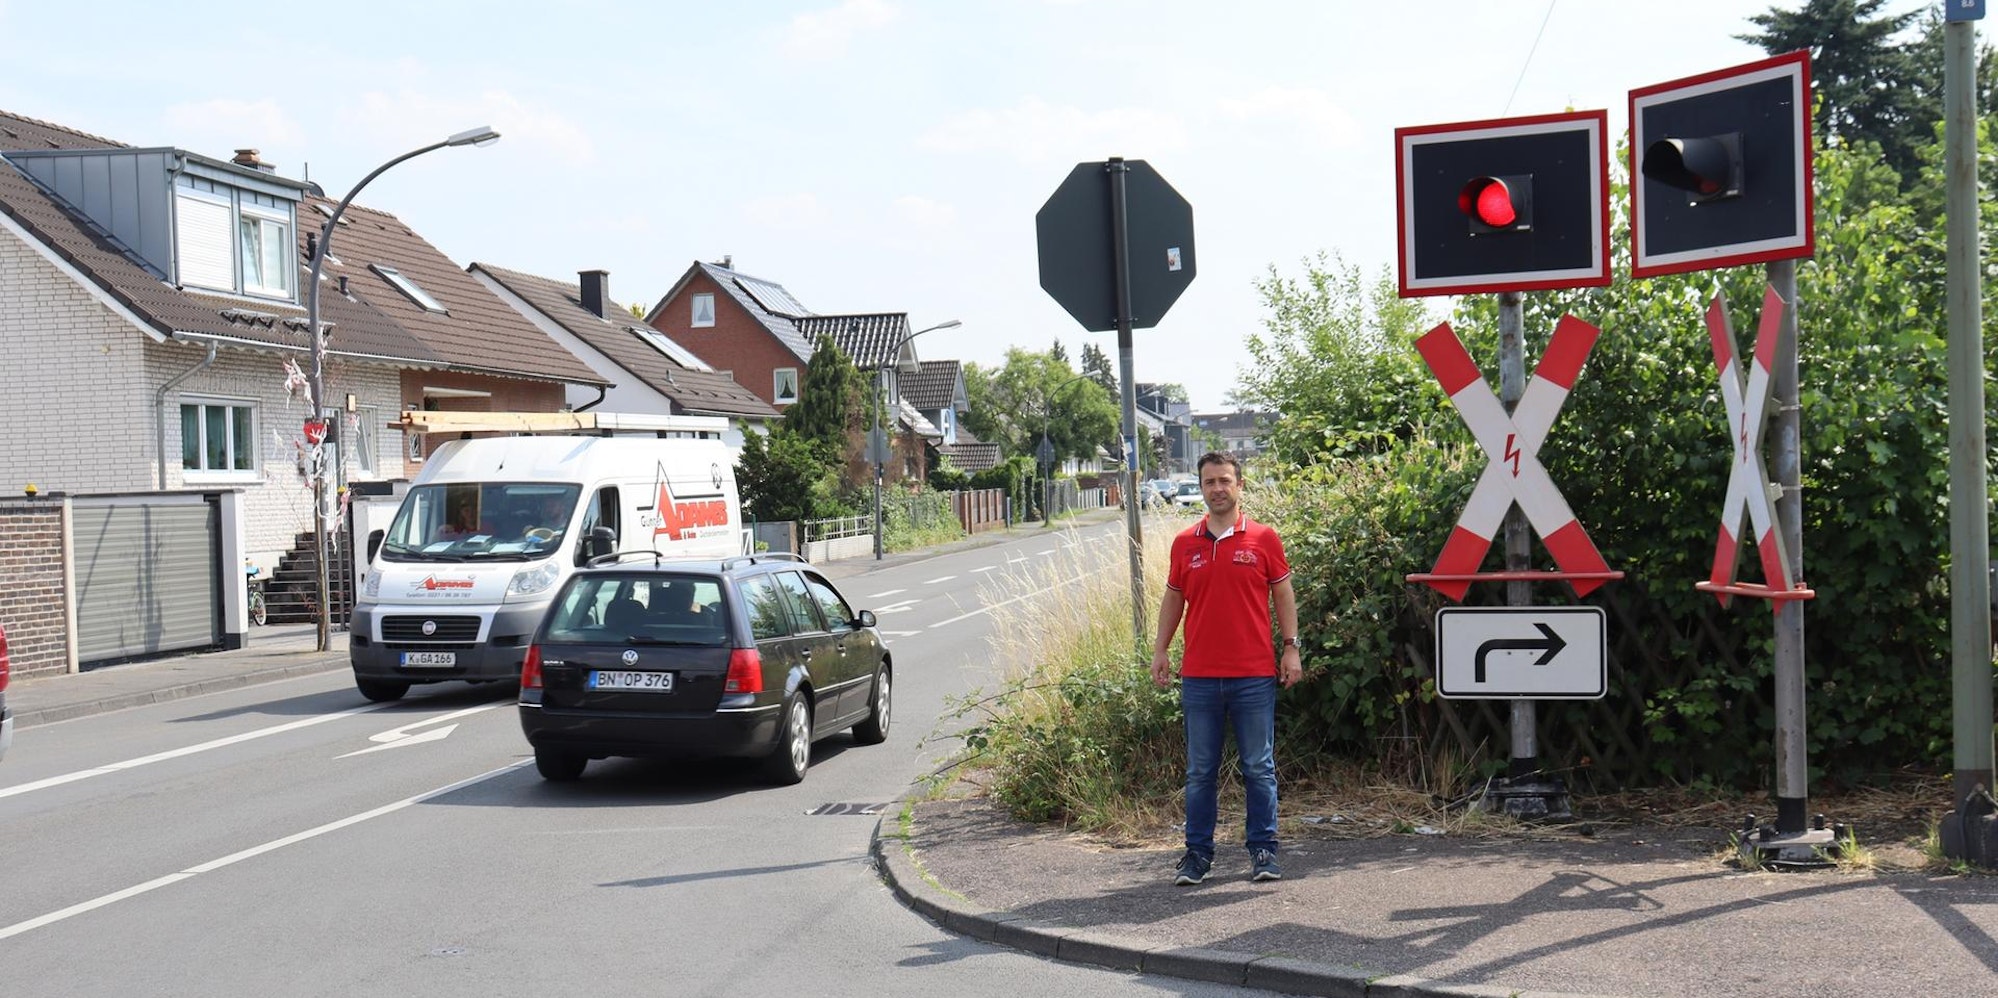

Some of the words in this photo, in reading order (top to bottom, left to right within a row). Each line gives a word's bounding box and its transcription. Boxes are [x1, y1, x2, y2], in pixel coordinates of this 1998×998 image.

[434, 654, 452, 664] 166
[597, 673, 616, 686] BN
[624, 673, 642, 687] OP
[644, 674, 670, 688] 376
